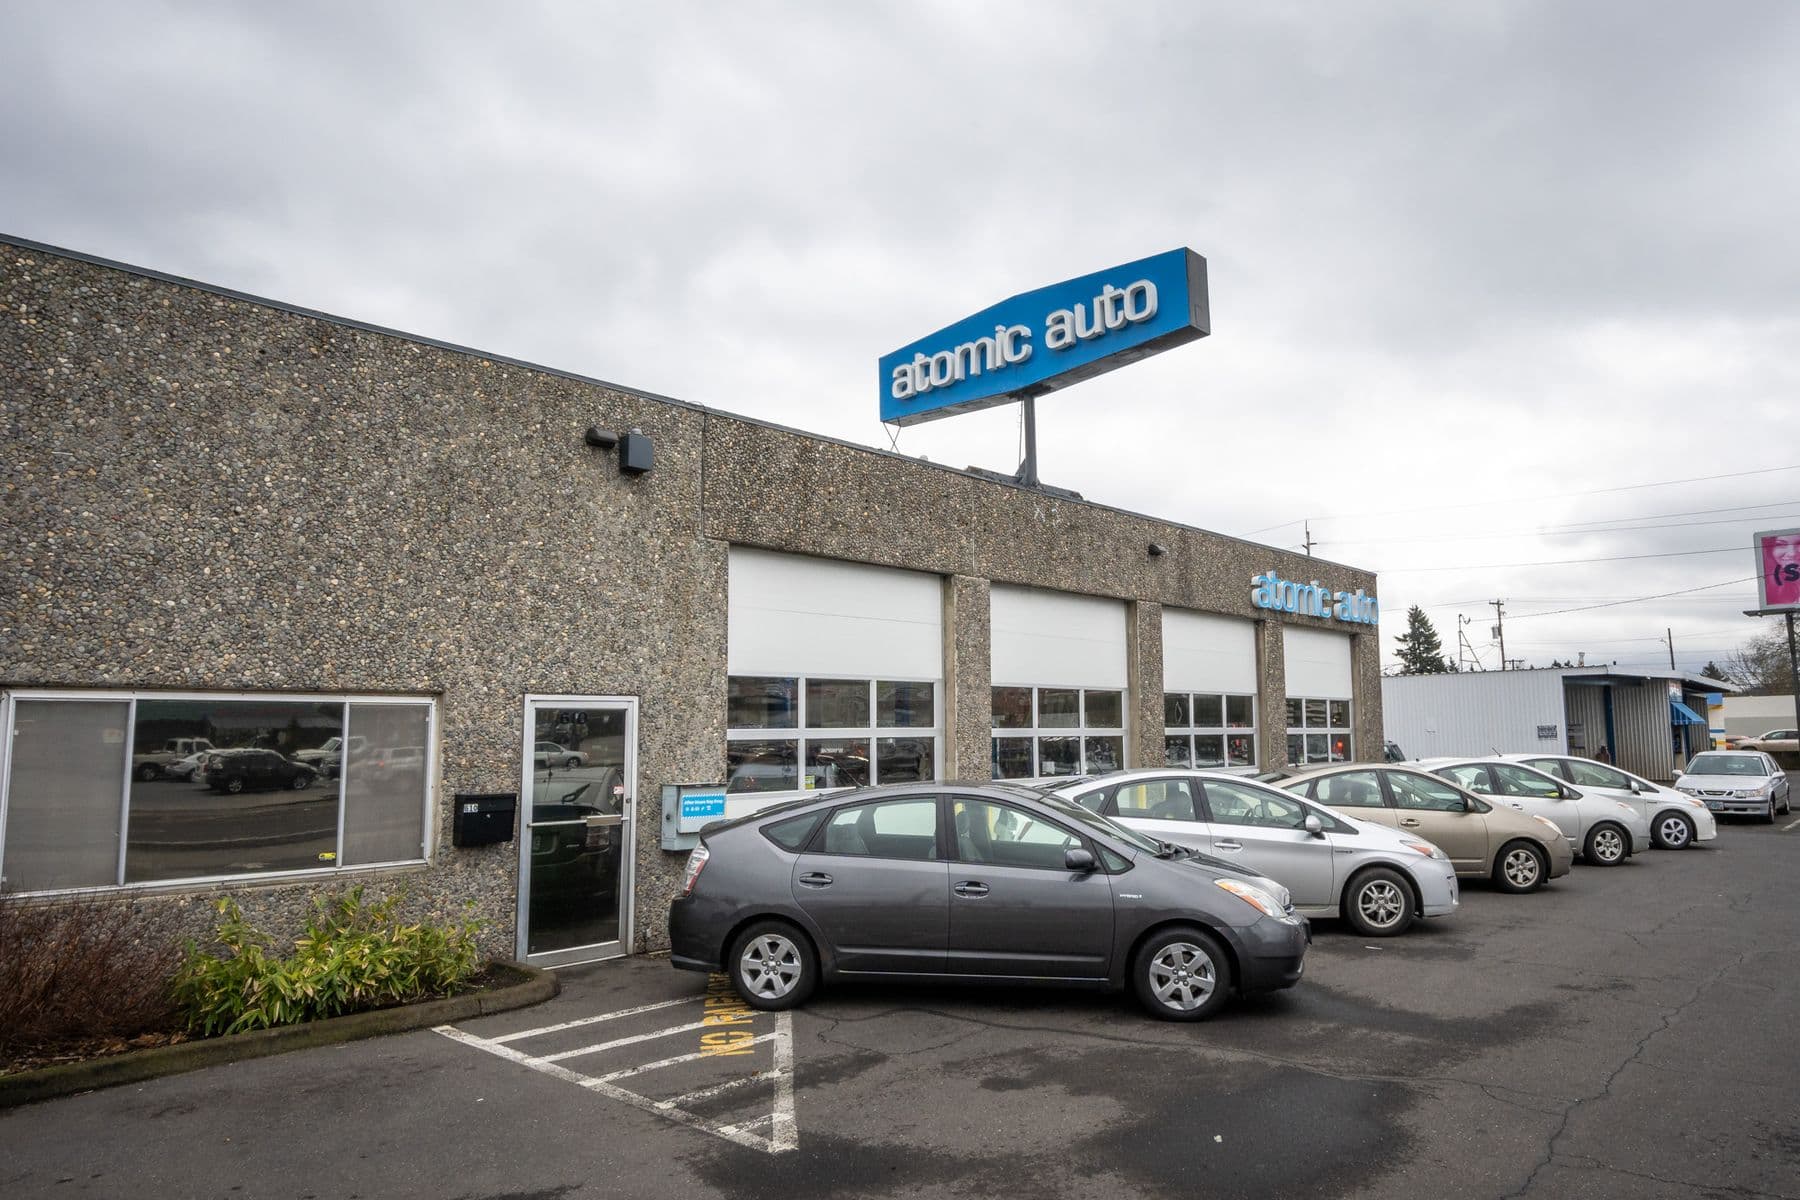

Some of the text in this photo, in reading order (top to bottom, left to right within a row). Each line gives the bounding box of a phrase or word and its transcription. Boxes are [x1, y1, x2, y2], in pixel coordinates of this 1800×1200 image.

[891, 278, 1159, 400] atomic auto
[1251, 569, 1379, 625] atomic auto
[700, 1031, 754, 1058] NO
